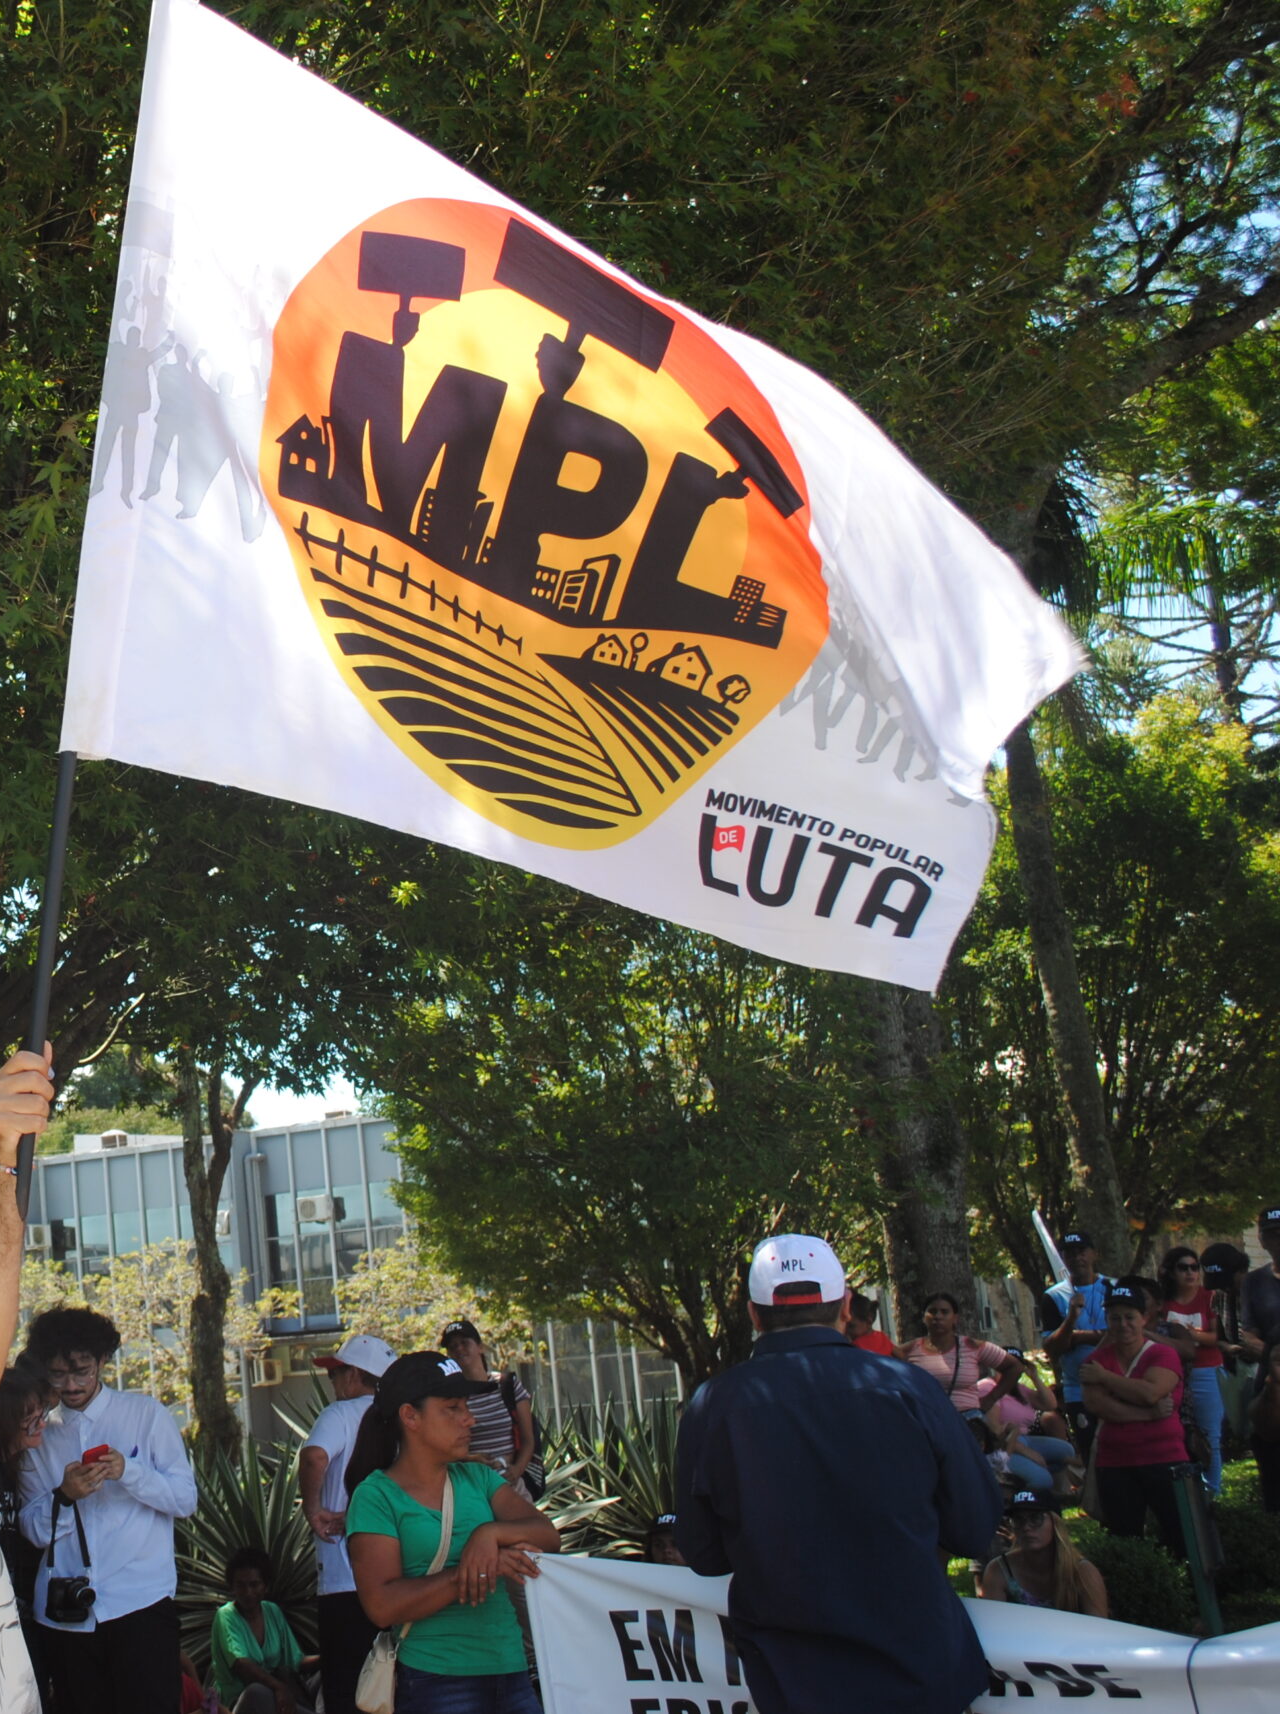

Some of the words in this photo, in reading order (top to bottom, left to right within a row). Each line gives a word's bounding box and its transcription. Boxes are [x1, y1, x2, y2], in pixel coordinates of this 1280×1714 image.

[277, 331, 788, 650] MPL
[699, 812, 932, 938] LUTA
[705, 788, 835, 837] MOVIMENTO
[839, 827, 944, 882] POPULAR
[719, 829, 738, 844] DE
[781, 1259, 805, 1272] MPL
[609, 1609, 704, 1683] EM
